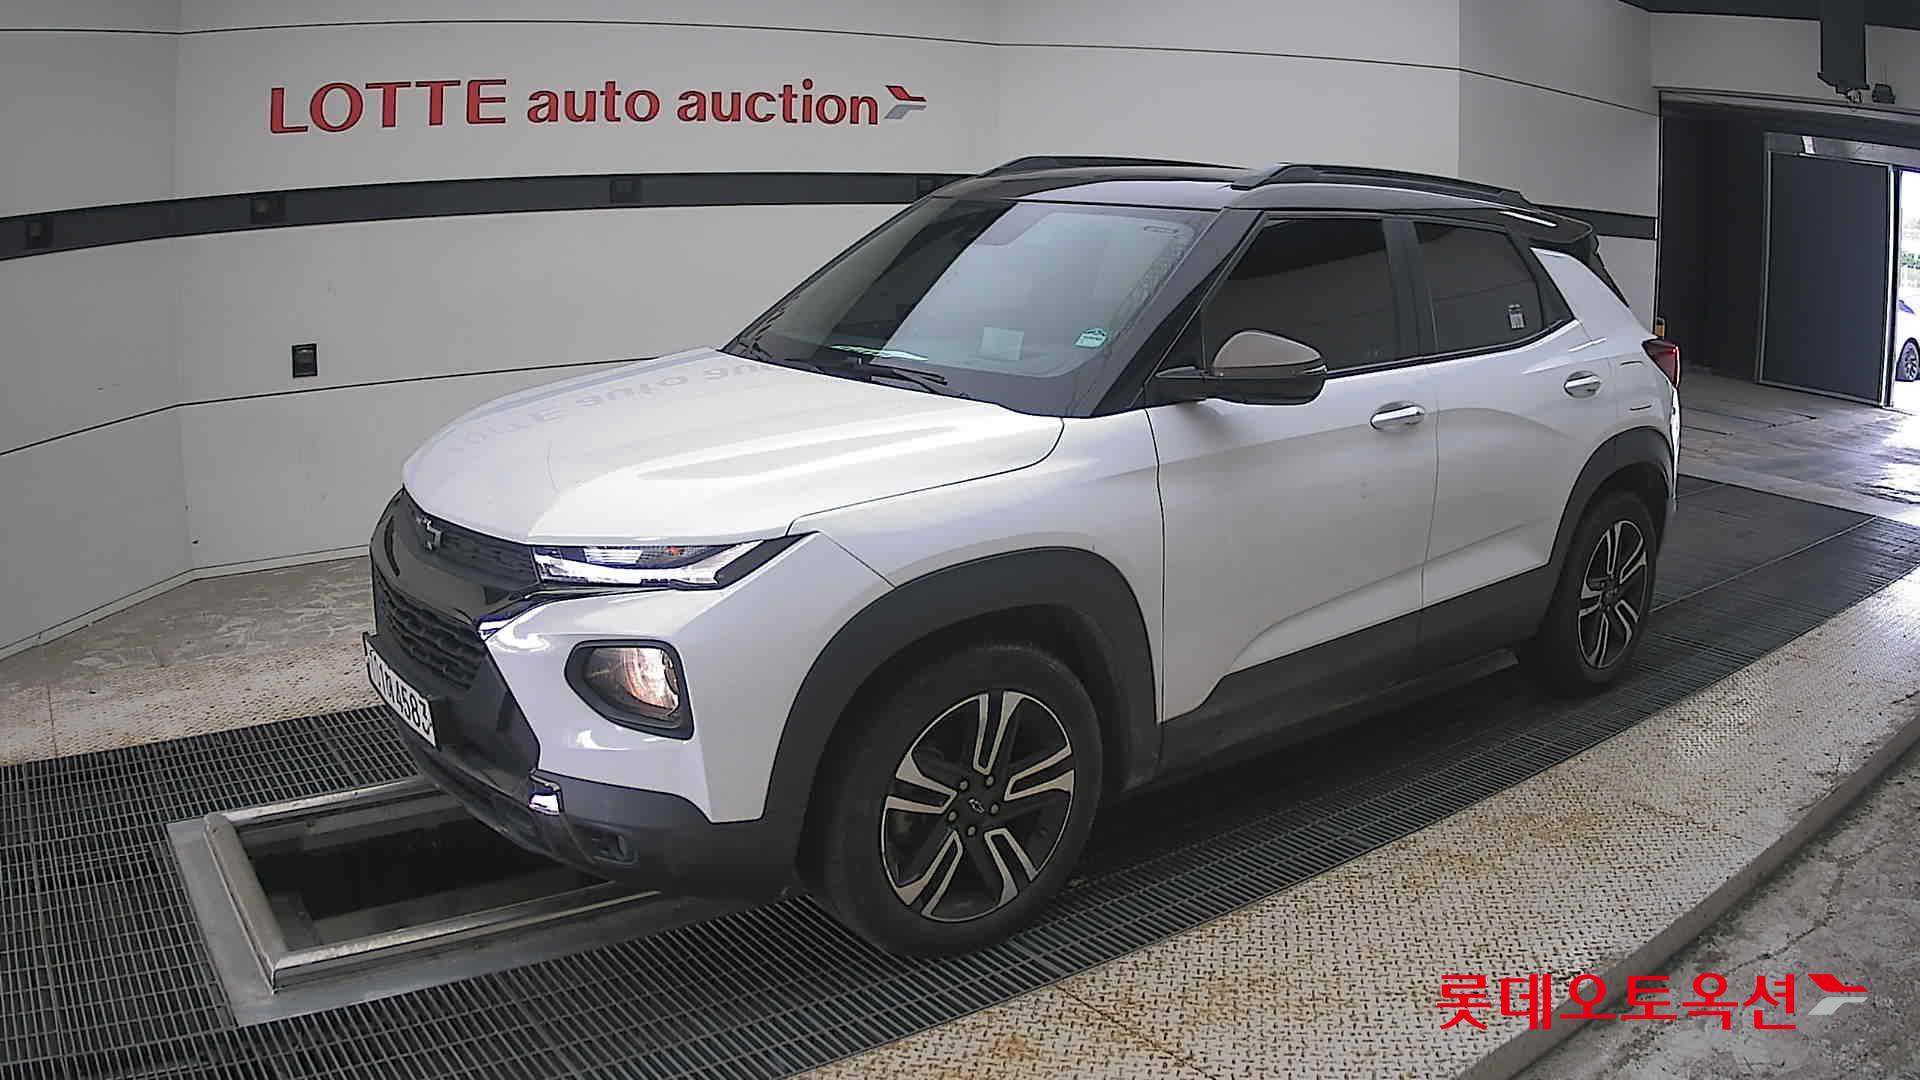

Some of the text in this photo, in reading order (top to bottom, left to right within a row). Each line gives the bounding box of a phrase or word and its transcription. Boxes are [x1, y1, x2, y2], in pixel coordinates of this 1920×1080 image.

[270, 79, 878, 134] LOTTE auto auction
